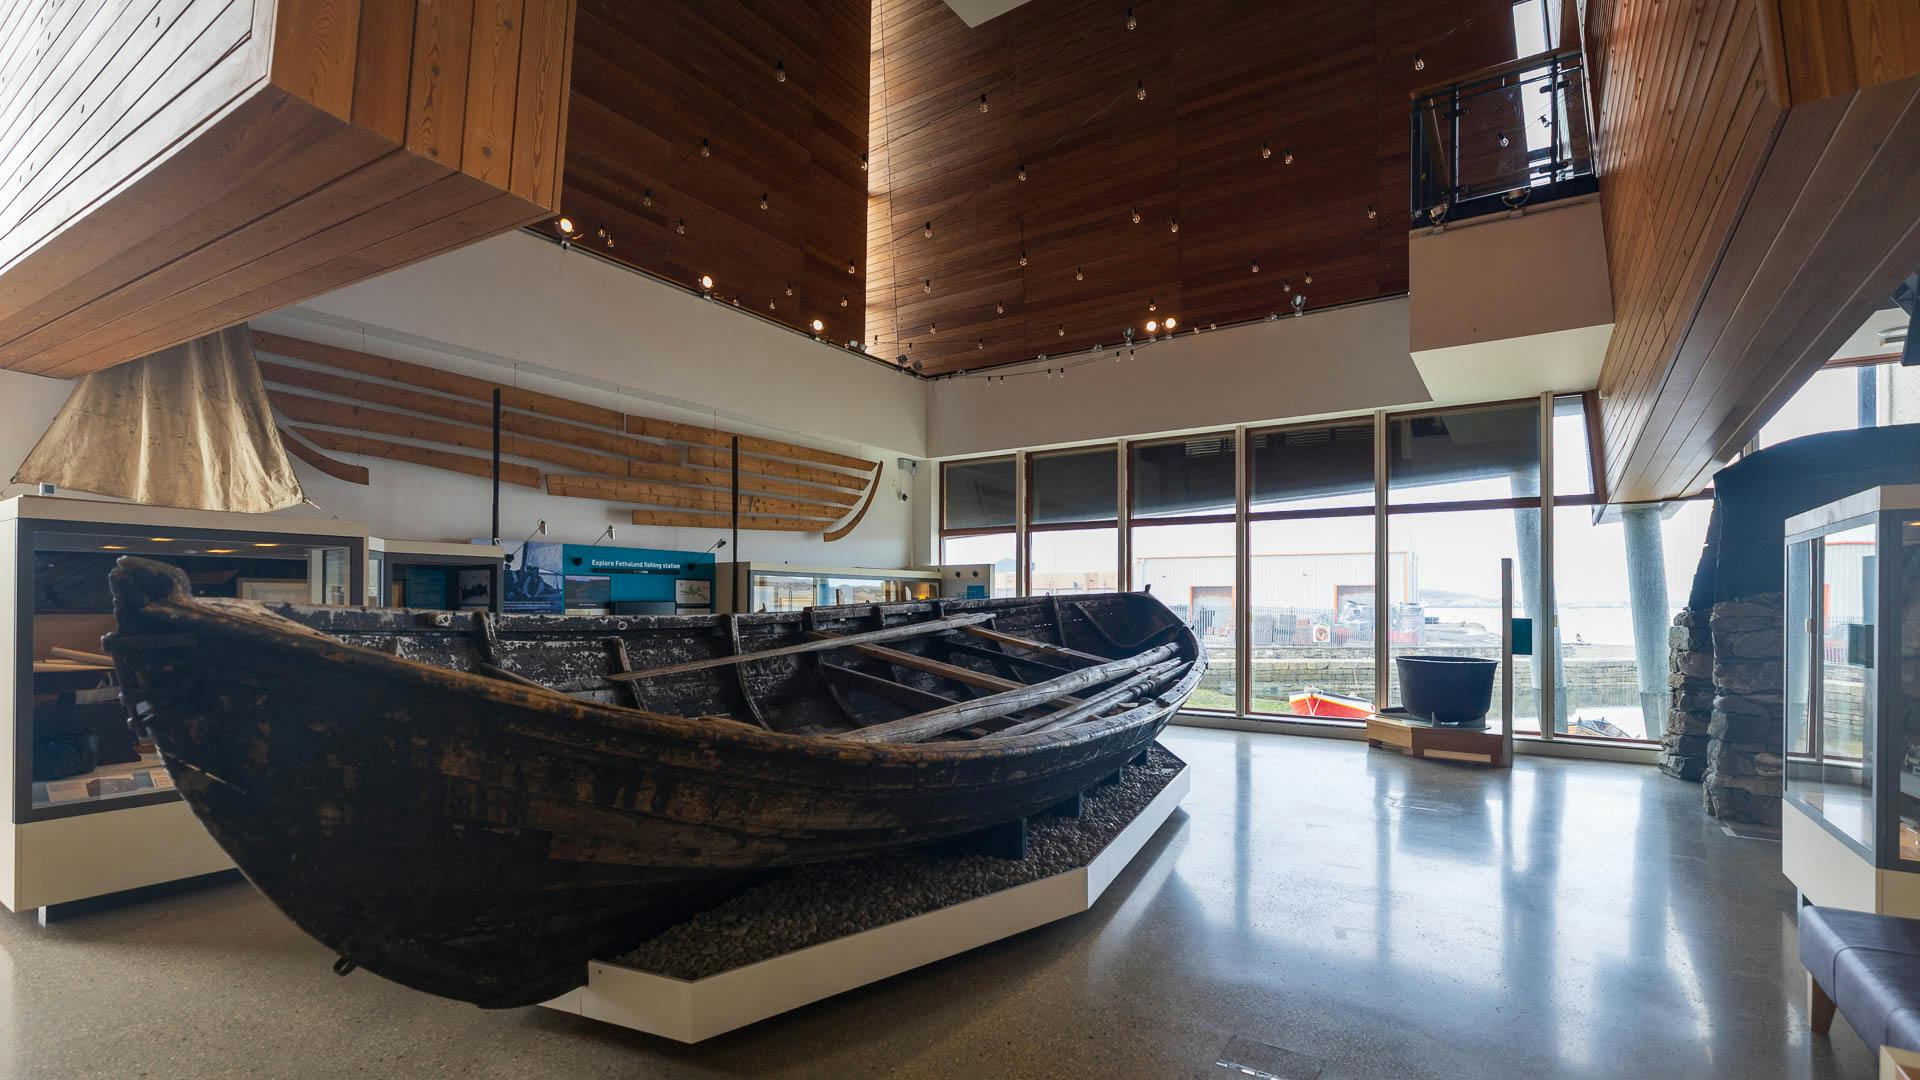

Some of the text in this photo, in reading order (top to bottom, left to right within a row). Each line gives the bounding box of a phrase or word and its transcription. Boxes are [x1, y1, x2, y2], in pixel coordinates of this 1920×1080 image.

[591, 559, 615, 567] Explore
[615, 560, 643, 568] Fethaland
[643, 561, 662, 570] fishing
